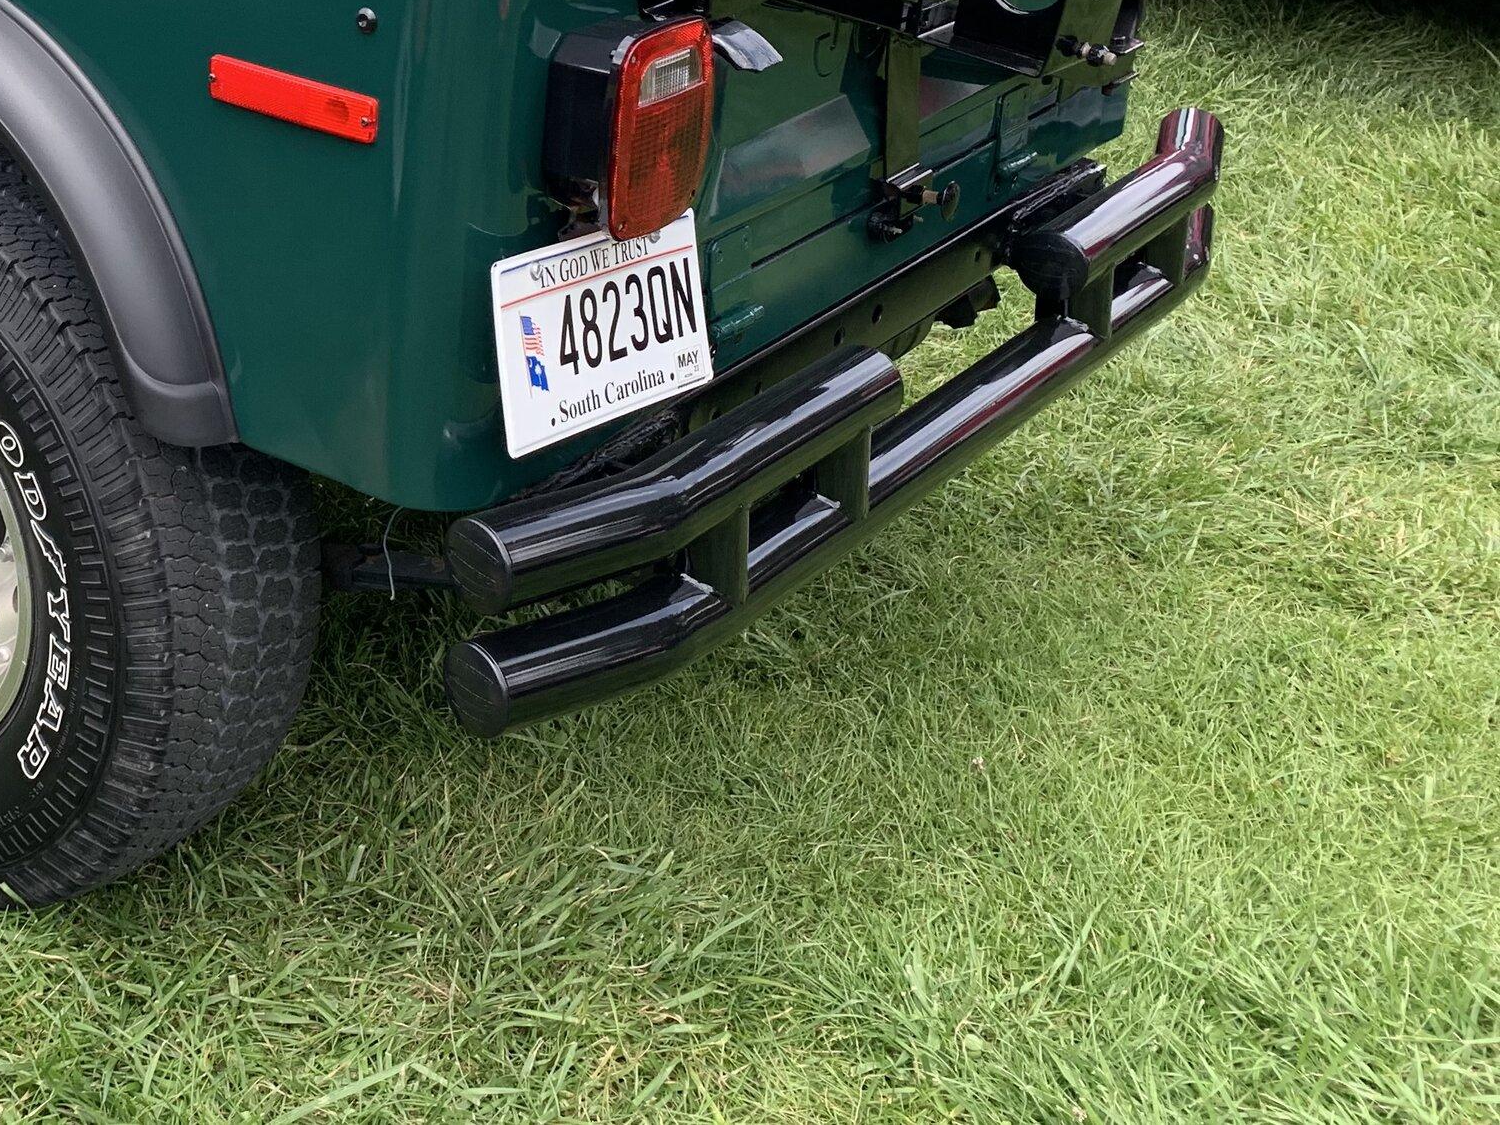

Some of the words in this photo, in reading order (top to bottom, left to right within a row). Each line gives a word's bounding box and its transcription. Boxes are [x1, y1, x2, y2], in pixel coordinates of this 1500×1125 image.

[539, 264, 556, 288] IN
[559, 258, 588, 283] GOD
[589, 249, 610, 271] WE
[611, 236, 650, 264] TRUST
[560, 257, 697, 375] 4823QN
[678, 349, 698, 368] MAY
[559, 390, 601, 423] South
[604, 368, 666, 405] Carolina
